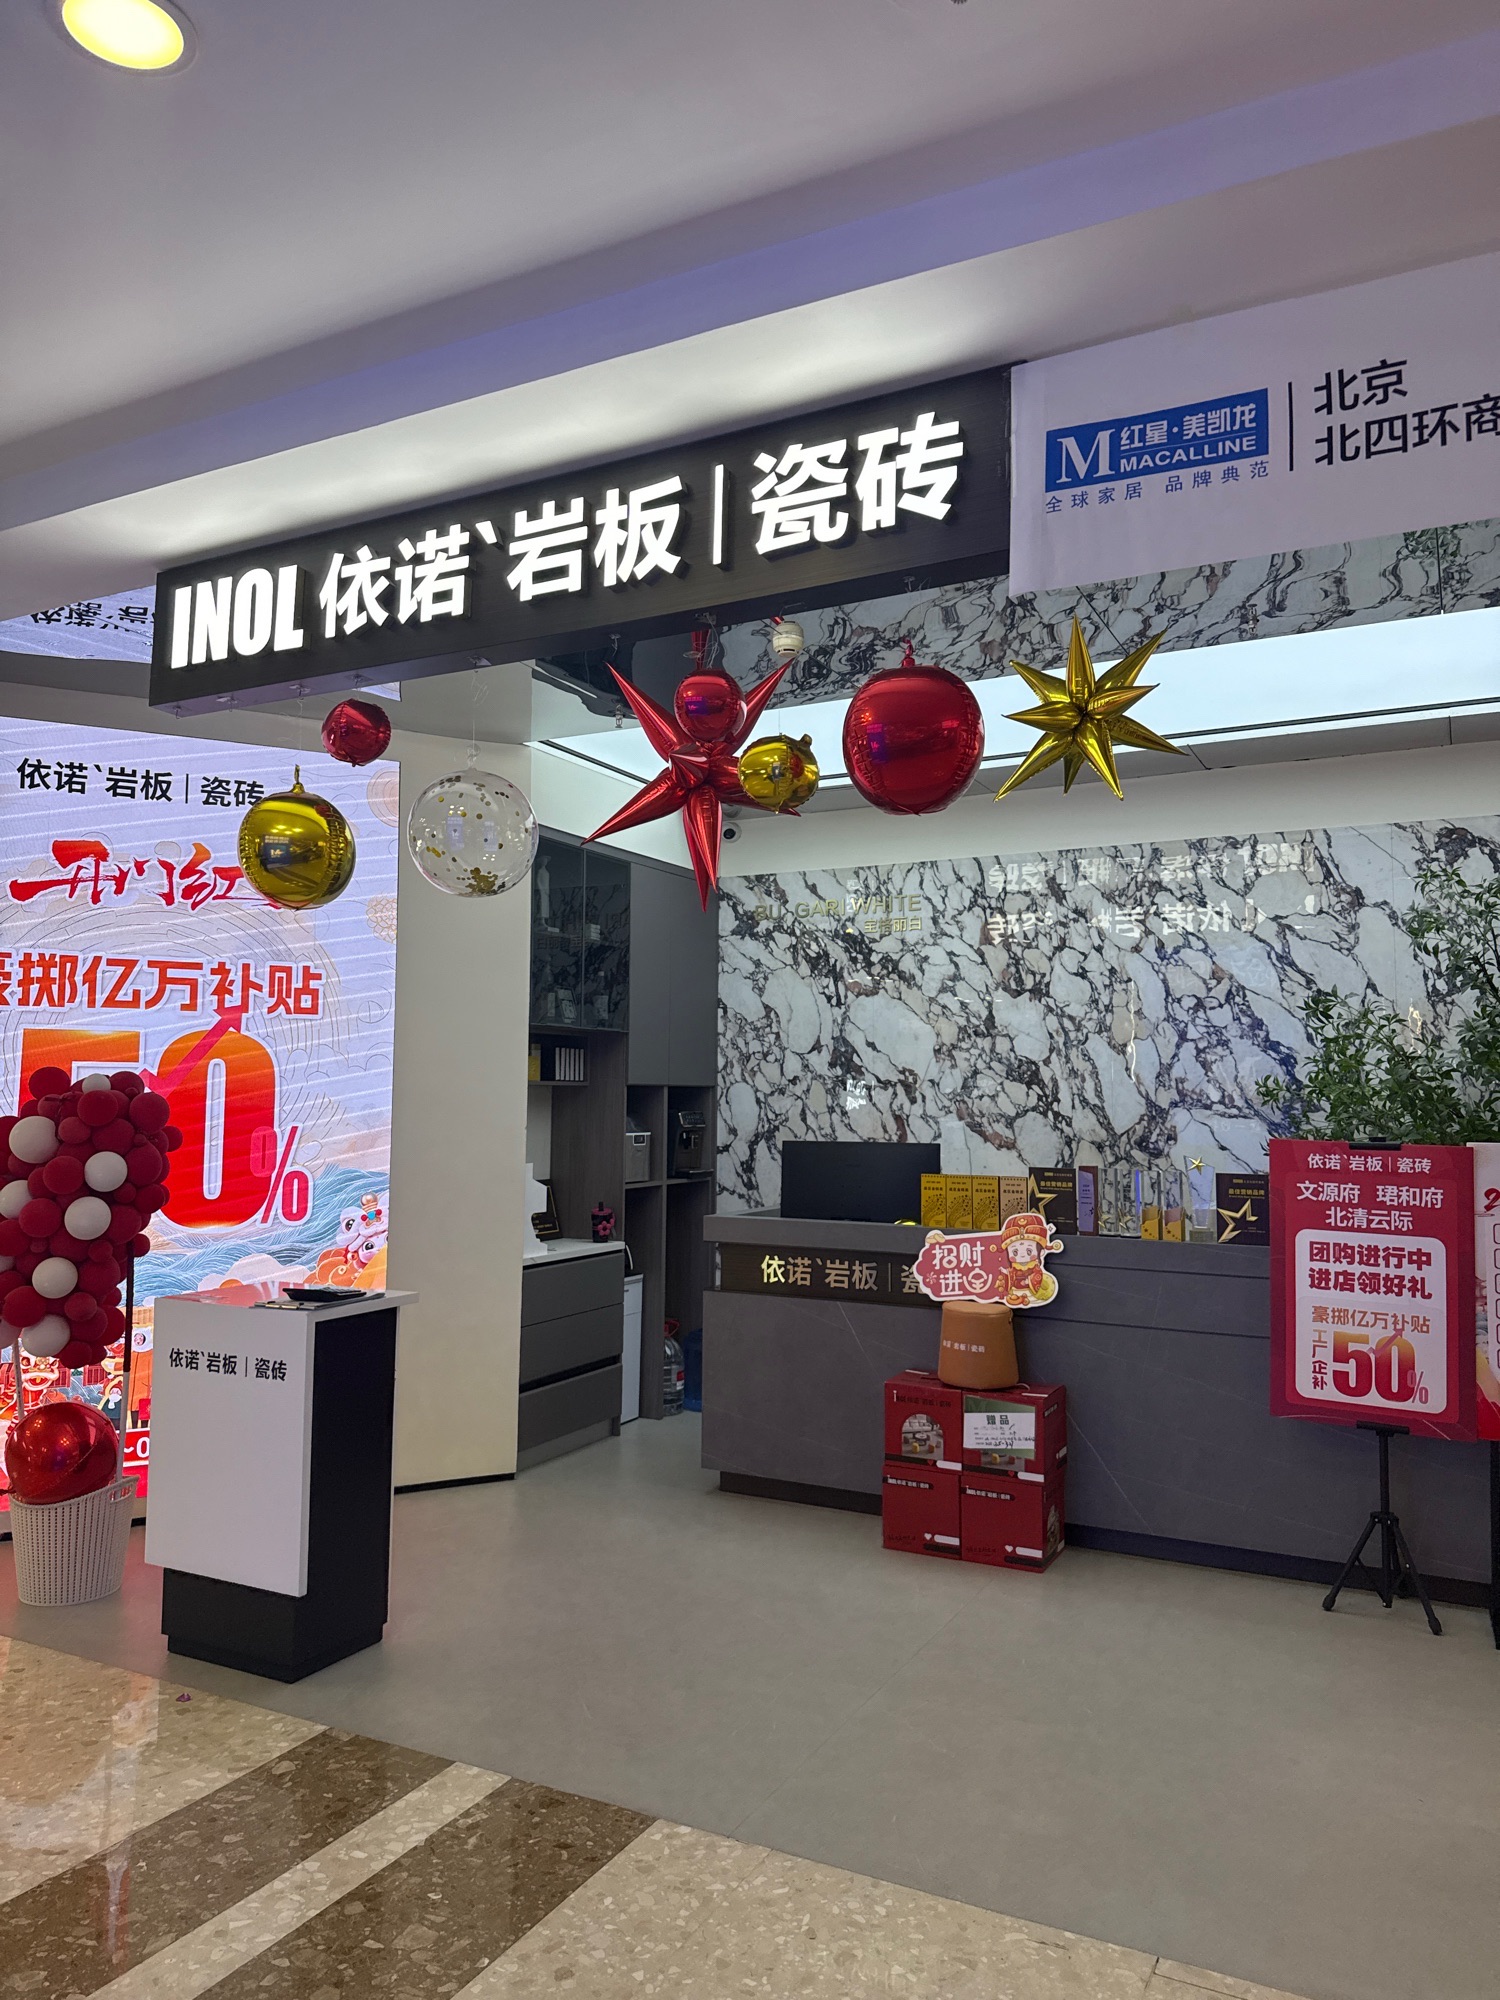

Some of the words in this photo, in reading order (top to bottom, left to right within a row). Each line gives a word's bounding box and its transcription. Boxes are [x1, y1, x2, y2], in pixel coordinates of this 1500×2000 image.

[1313, 358, 1408, 415] 北京
[1314, 393, 1500, 466] 北四环商
[1119, 435, 1257, 473] MACALLINE
[1045, 481, 1143, 514] 全球家居
[1165, 460, 1270, 493] 品牌典范
[170, 563, 305, 669] INOL
[750, 410, 965, 556] 瓷砖
[850, 893, 922, 914] WHITE
[0, 952, 322, 1016] 掷亿万补贴
[1396, 1157, 1432, 1174] 瓷砖
[1296, 1180, 1361, 1204] 文源府
[1376, 1185, 1444, 1209] 珺和府
[1325, 1206, 1413, 1231] 北清云际
[932, 1241, 985, 1270] 招财
[1309, 1241, 1432, 1271] 团购进行中
[1308, 1267, 1433, 1300] 进店领好礼
[1312, 1305, 1431, 1335] 豪掷亿万补贴
[254, 1357, 288, 1382] 瓷砖
[1332, 1330, 1430, 1405] 50%
